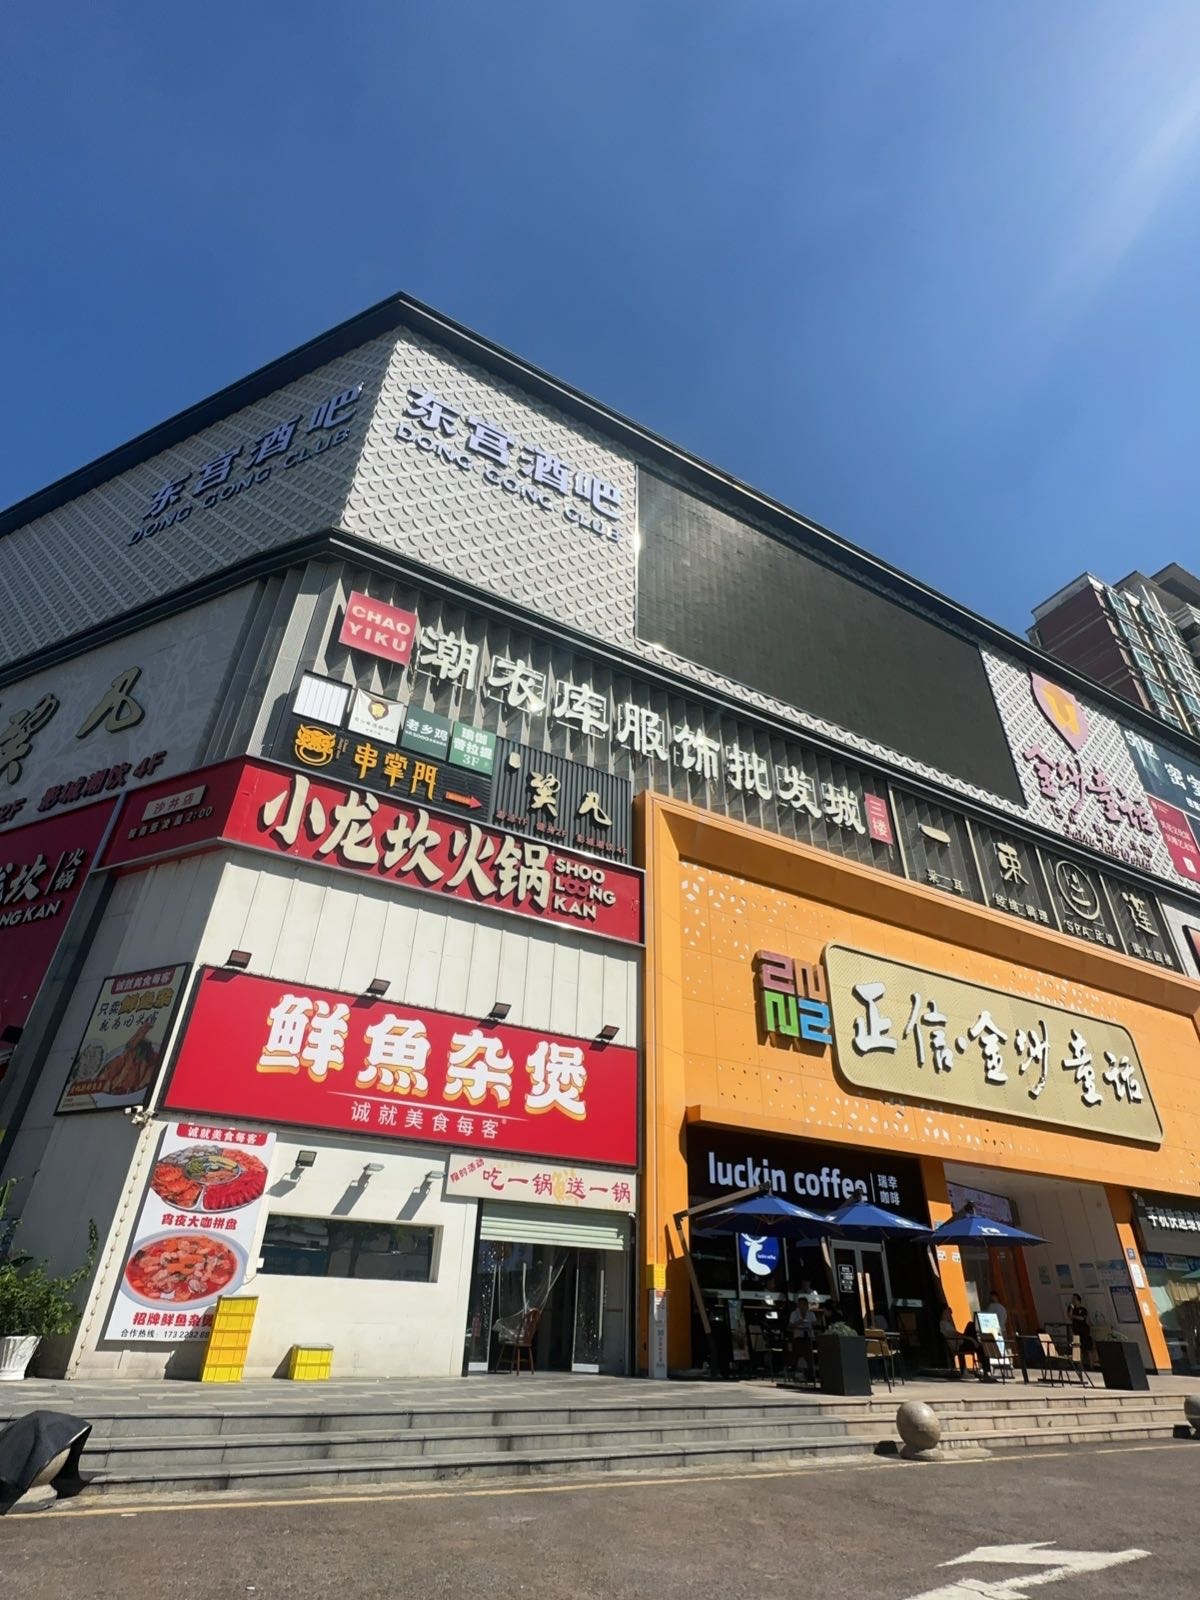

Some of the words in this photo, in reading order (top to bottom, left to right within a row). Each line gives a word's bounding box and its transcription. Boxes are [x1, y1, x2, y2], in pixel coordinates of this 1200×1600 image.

[142, 382, 364, 520] 东宫酒吧
[404, 385, 622, 519] 东宫酒吧
[128, 506, 193, 546] DONG
[203, 467, 272, 508] GONG
[283, 428, 351, 469] CLUB
[396, 424, 473, 470] DONG
[484, 467, 555, 510] GONG
[565, 505, 622, 543] CLUB
[351, 605, 412, 636] CHAO
[348, 621, 408, 652] YIKU
[406, 718, 449, 741] 老乡鸡
[420, 626, 866, 834] 潮衣库服饰批发城
[133, 750, 168, 779] 4F
[353, 742, 439, 801] 串掌門
[462, 754, 480, 767] 3F
[152, 792, 195, 814] 沙井店
[870, 797, 889, 838] 三楼
[262, 774, 550, 910] 小龙坎火锅
[55, 848, 84, 891] 火锅
[555, 858, 605, 884] SHOO
[555, 876, 616, 905] LOONG
[554, 895, 597, 919] KAN
[256, 993, 587, 1120] 鲜魚杂煲
[187, 1126, 257, 1144] 诚就美食每客
[351, 1100, 499, 1140] 诚就美食每客
[450, 1156, 485, 1183] 限时活动
[708, 1151, 787, 1193] luckin
[794, 1166, 868, 1202] coffee
[878, 1174, 898, 1189] 瑞幸
[482, 1167, 552, 1196] 吃一锅
[566, 1177, 631, 1204] 送一锅
[880, 1191, 900, 1206] 咖啡
[161, 1213, 238, 1231] 宵夜大咖拼盘
